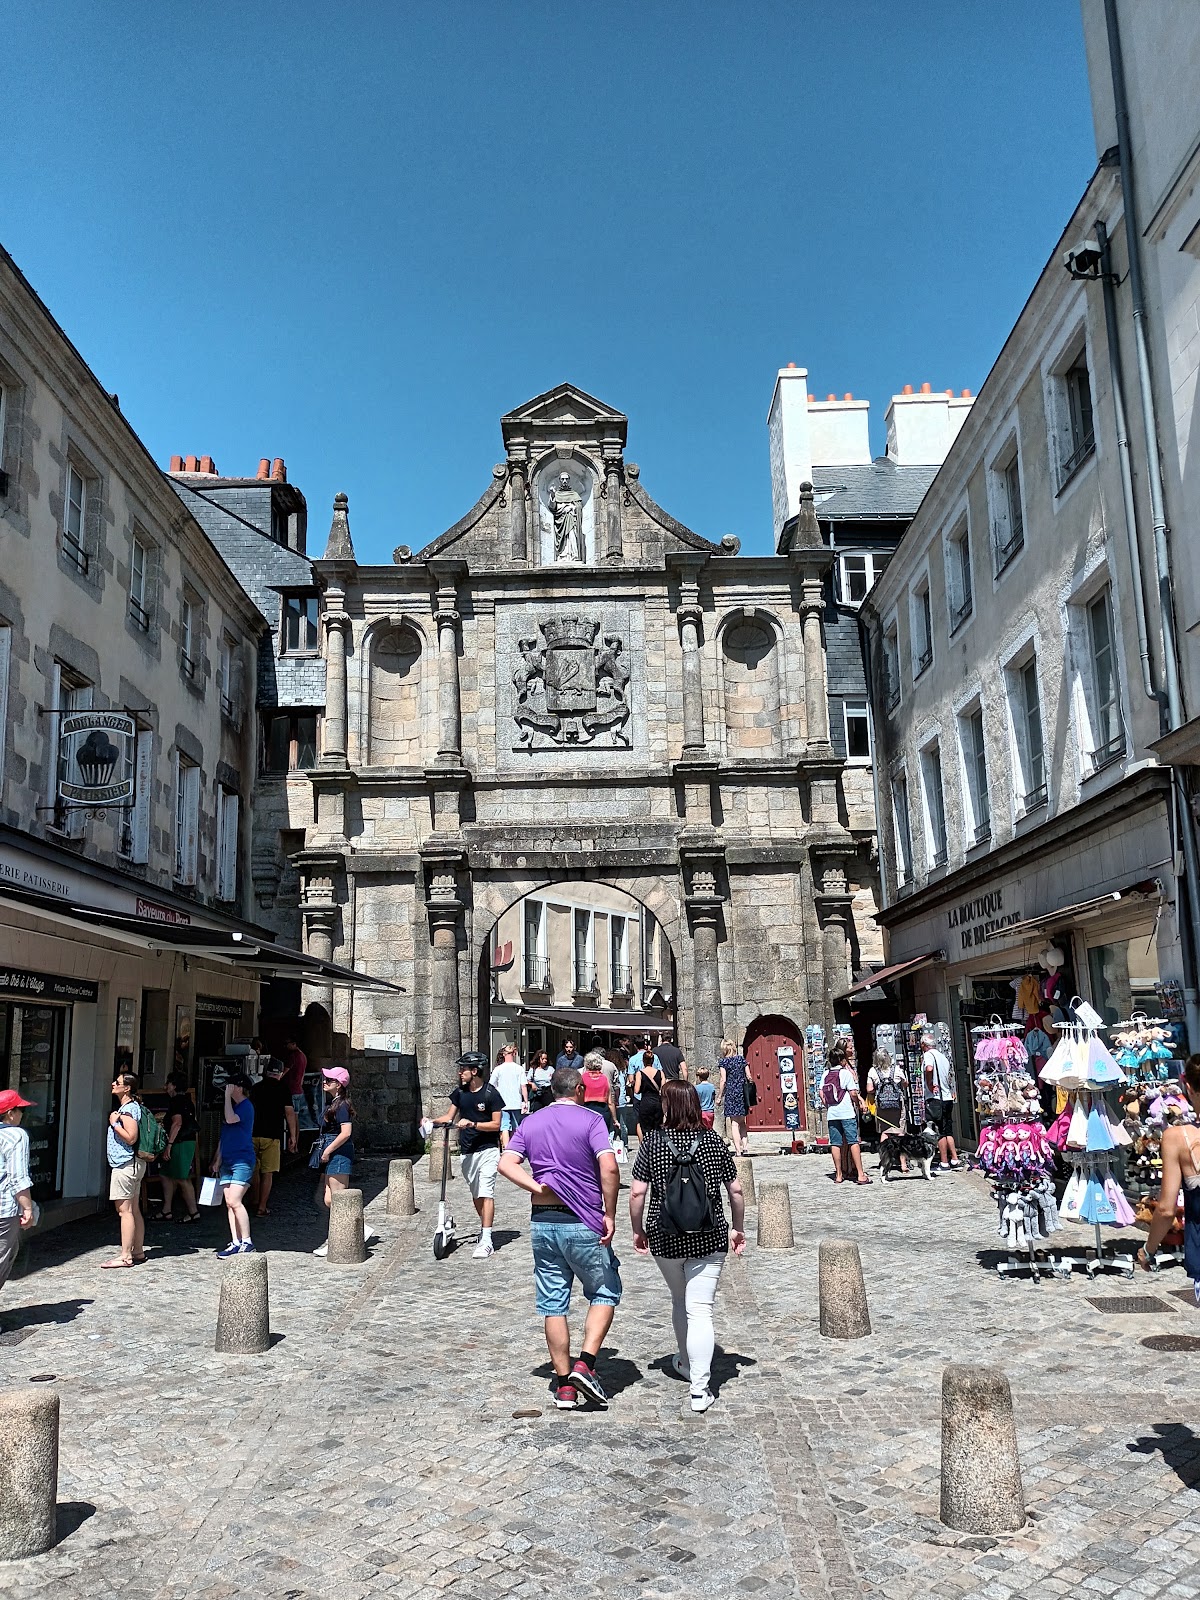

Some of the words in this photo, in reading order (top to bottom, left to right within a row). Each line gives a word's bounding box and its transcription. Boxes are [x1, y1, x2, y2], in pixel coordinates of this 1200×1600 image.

[24, 871, 71, 896] PATISSERIE
[948, 910, 958, 928] LA
[959, 890, 1003, 924] BOUTIQUE
[961, 928, 973, 949] DE
